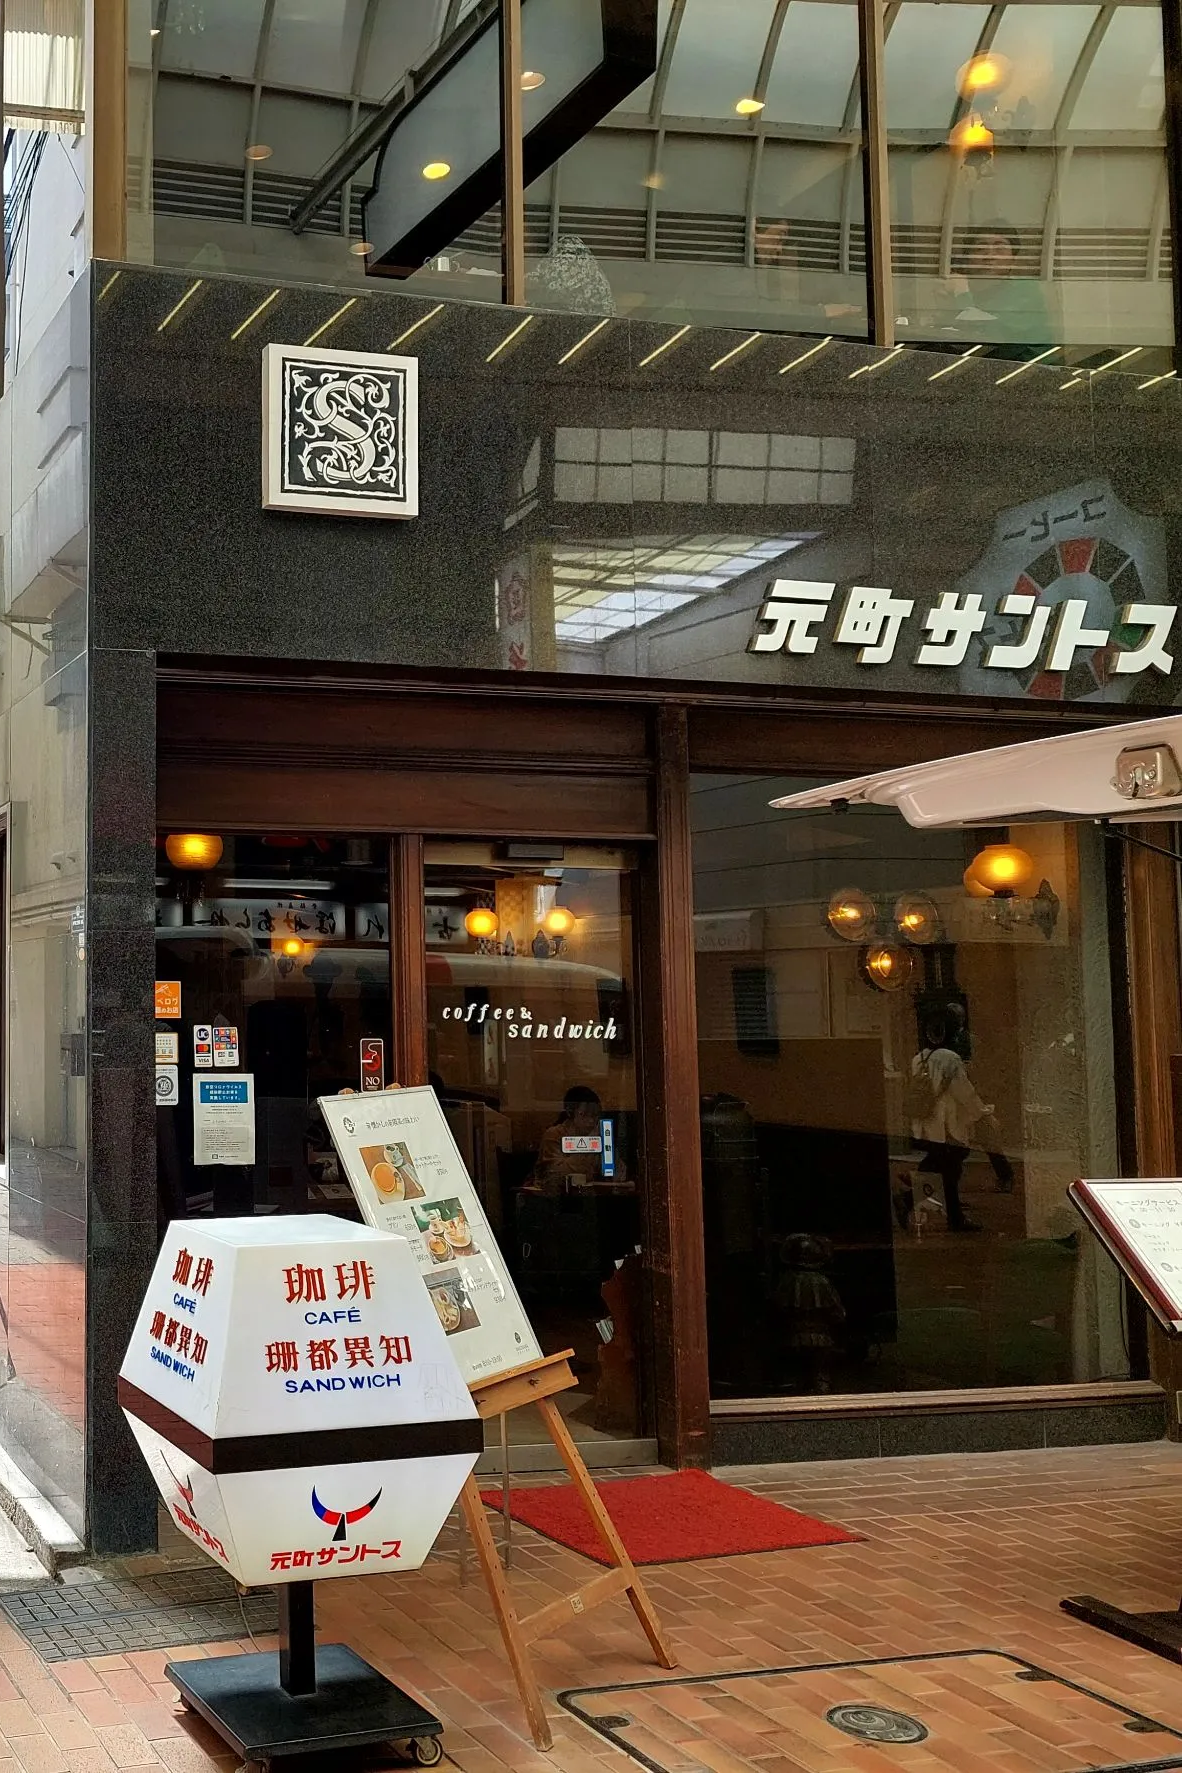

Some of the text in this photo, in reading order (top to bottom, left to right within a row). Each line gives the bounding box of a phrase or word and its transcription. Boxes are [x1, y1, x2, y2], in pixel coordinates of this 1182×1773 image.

[746, 578, 1178, 676] 元町サントス
[508, 1017, 618, 1039] sandwich
[365, 1076, 380, 1085] NO
[172, 1246, 215, 1297] 珈琲
[282, 1260, 376, 1305] 珈琲
[172, 1291, 198, 1315] CAFÉ
[304, 1307, 362, 1325] CAFÉ
[149, 1309, 209, 1366] 珊都異知
[264, 1334, 413, 1374] 珊都異知
[269, 1540, 403, 1571] 元町サントス
